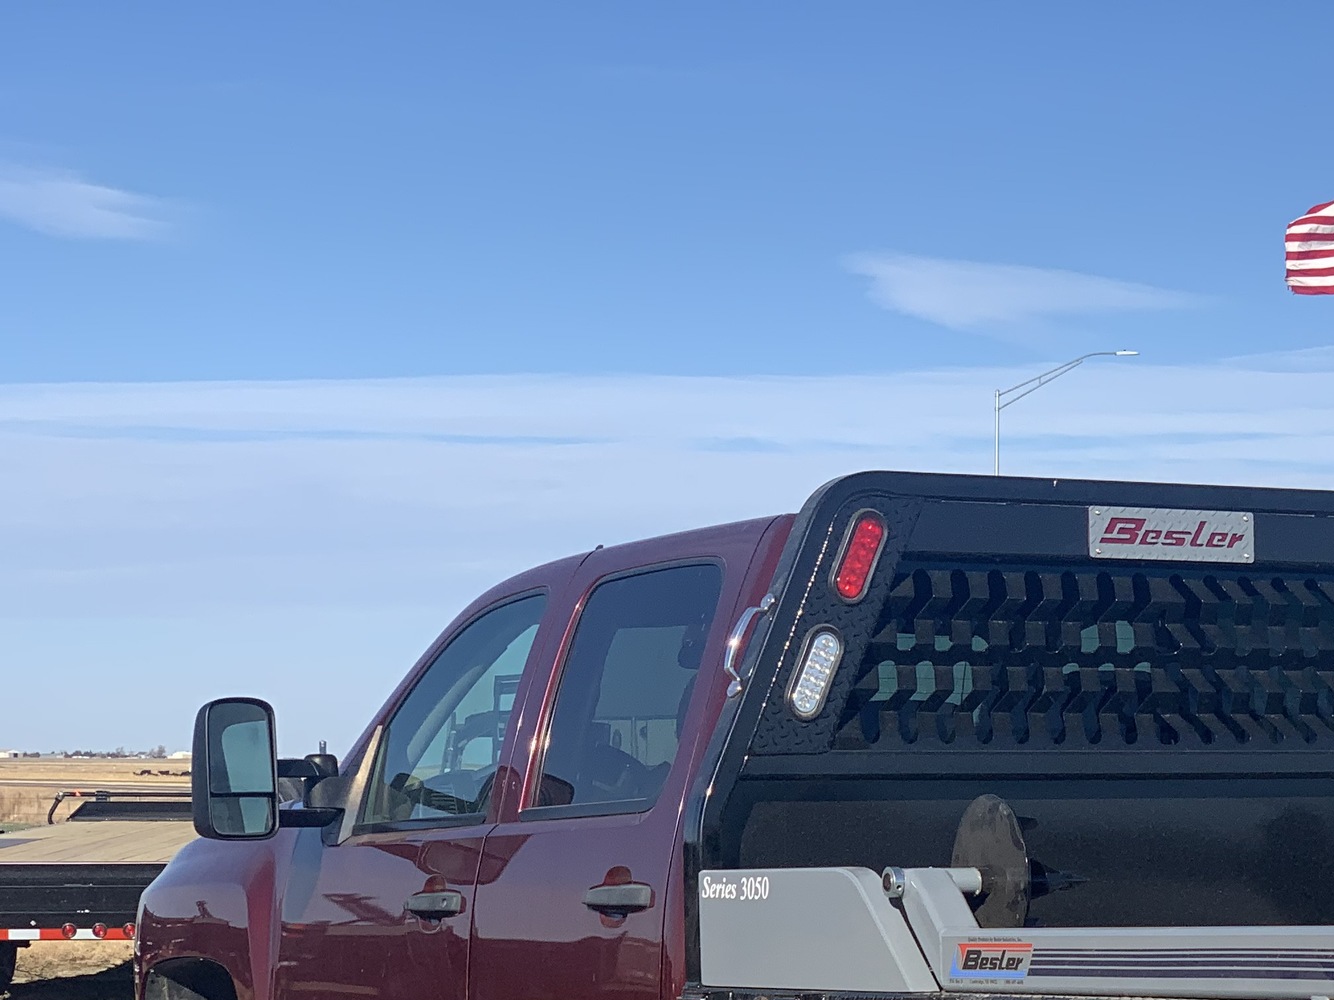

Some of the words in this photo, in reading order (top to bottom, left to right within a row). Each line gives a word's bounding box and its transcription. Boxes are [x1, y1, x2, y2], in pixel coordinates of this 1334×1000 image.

[1099, 517, 1245, 548] Besler
[701, 876, 737, 900] Series
[740, 876, 770, 900] 3050
[962, 949, 1024, 971] Besler
